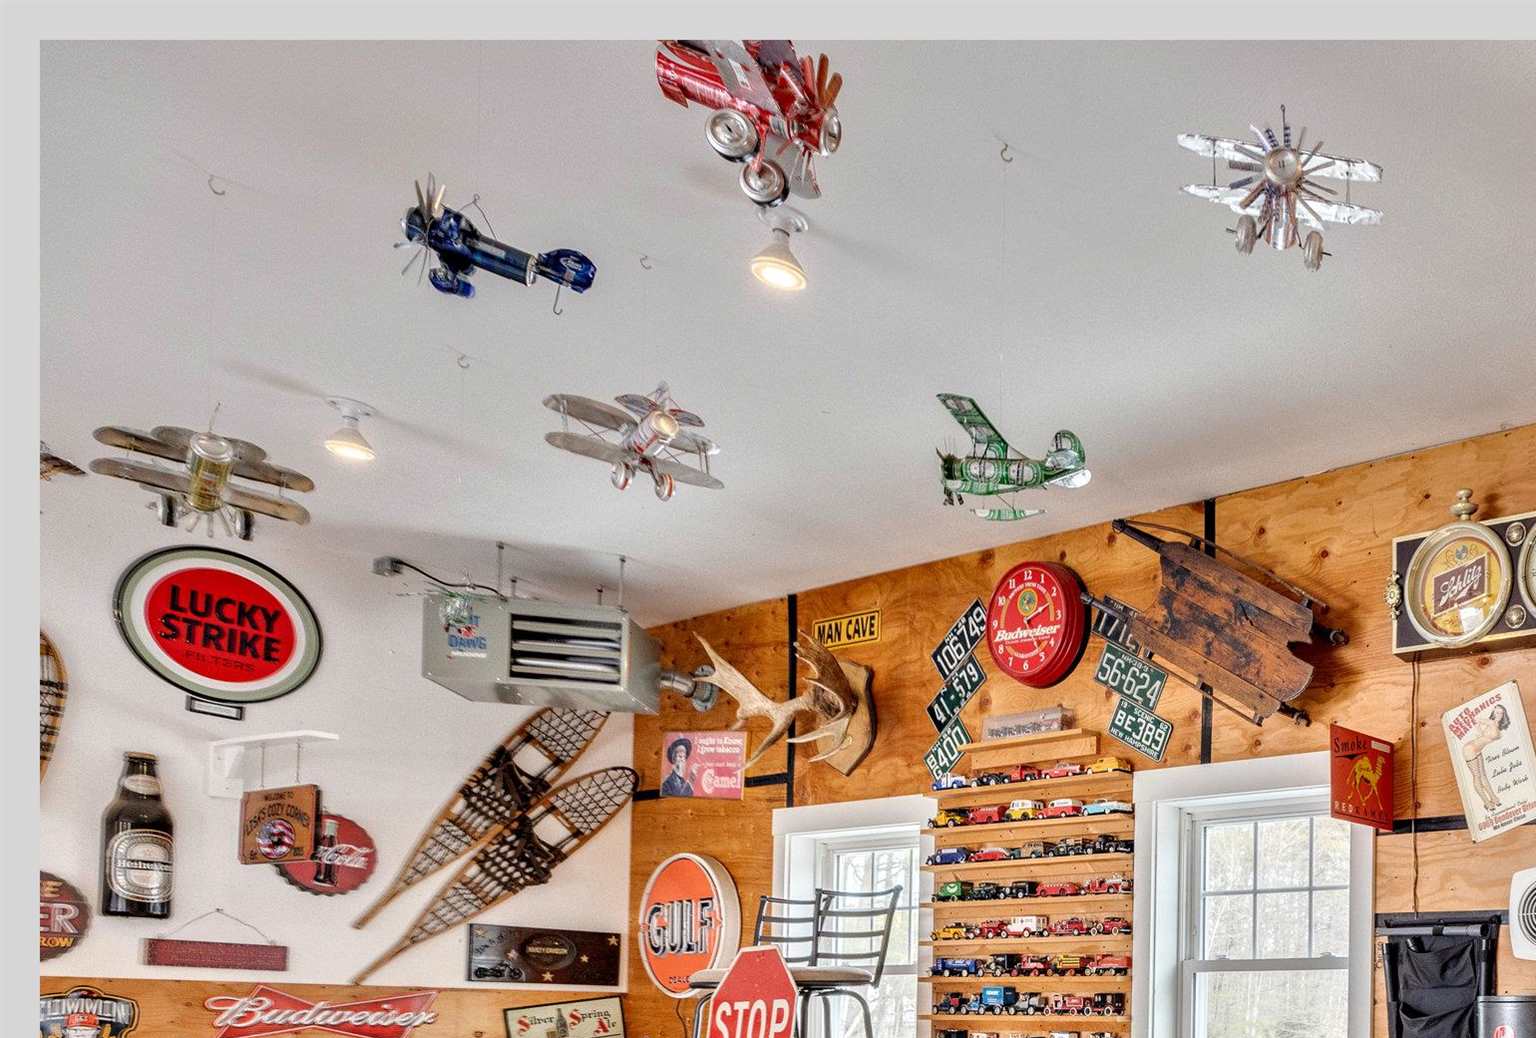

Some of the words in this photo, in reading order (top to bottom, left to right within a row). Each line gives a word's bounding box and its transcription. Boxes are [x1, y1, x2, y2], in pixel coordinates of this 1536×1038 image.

[1024, 570, 1032, 580] 12
[1439, 564, 1482, 607] Schlitz
[169, 584, 282, 633] LUCKY
[159, 612, 282, 664] STRIKE
[817, 621, 842, 645] MAN
[845, 614, 877, 641] CAVE
[936, 605, 986, 676] 106749
[994, 624, 1062, 642] Budweiser
[184, 650, 256, 673] FILTERS
[1114, 709, 1166, 752] BE389
[1133, 707, 1155, 724] SCENIC
[1452, 693, 1502, 737] MECHANICS
[936, 725, 967, 768] 400
[1110, 727, 1124, 739] NEW
[1124, 735, 1159, 759] HAMPSHIRE
[1334, 735, 1367, 753] Smoke
[701, 768, 741, 795] Camel
[1334, 800, 1354, 813] RED
[648, 898, 714, 956] GULF
[205, 996, 439, 1028] Budweiser
[516, 1014, 555, 1037] Silver
[568, 1008, 612, 1031] Spring
